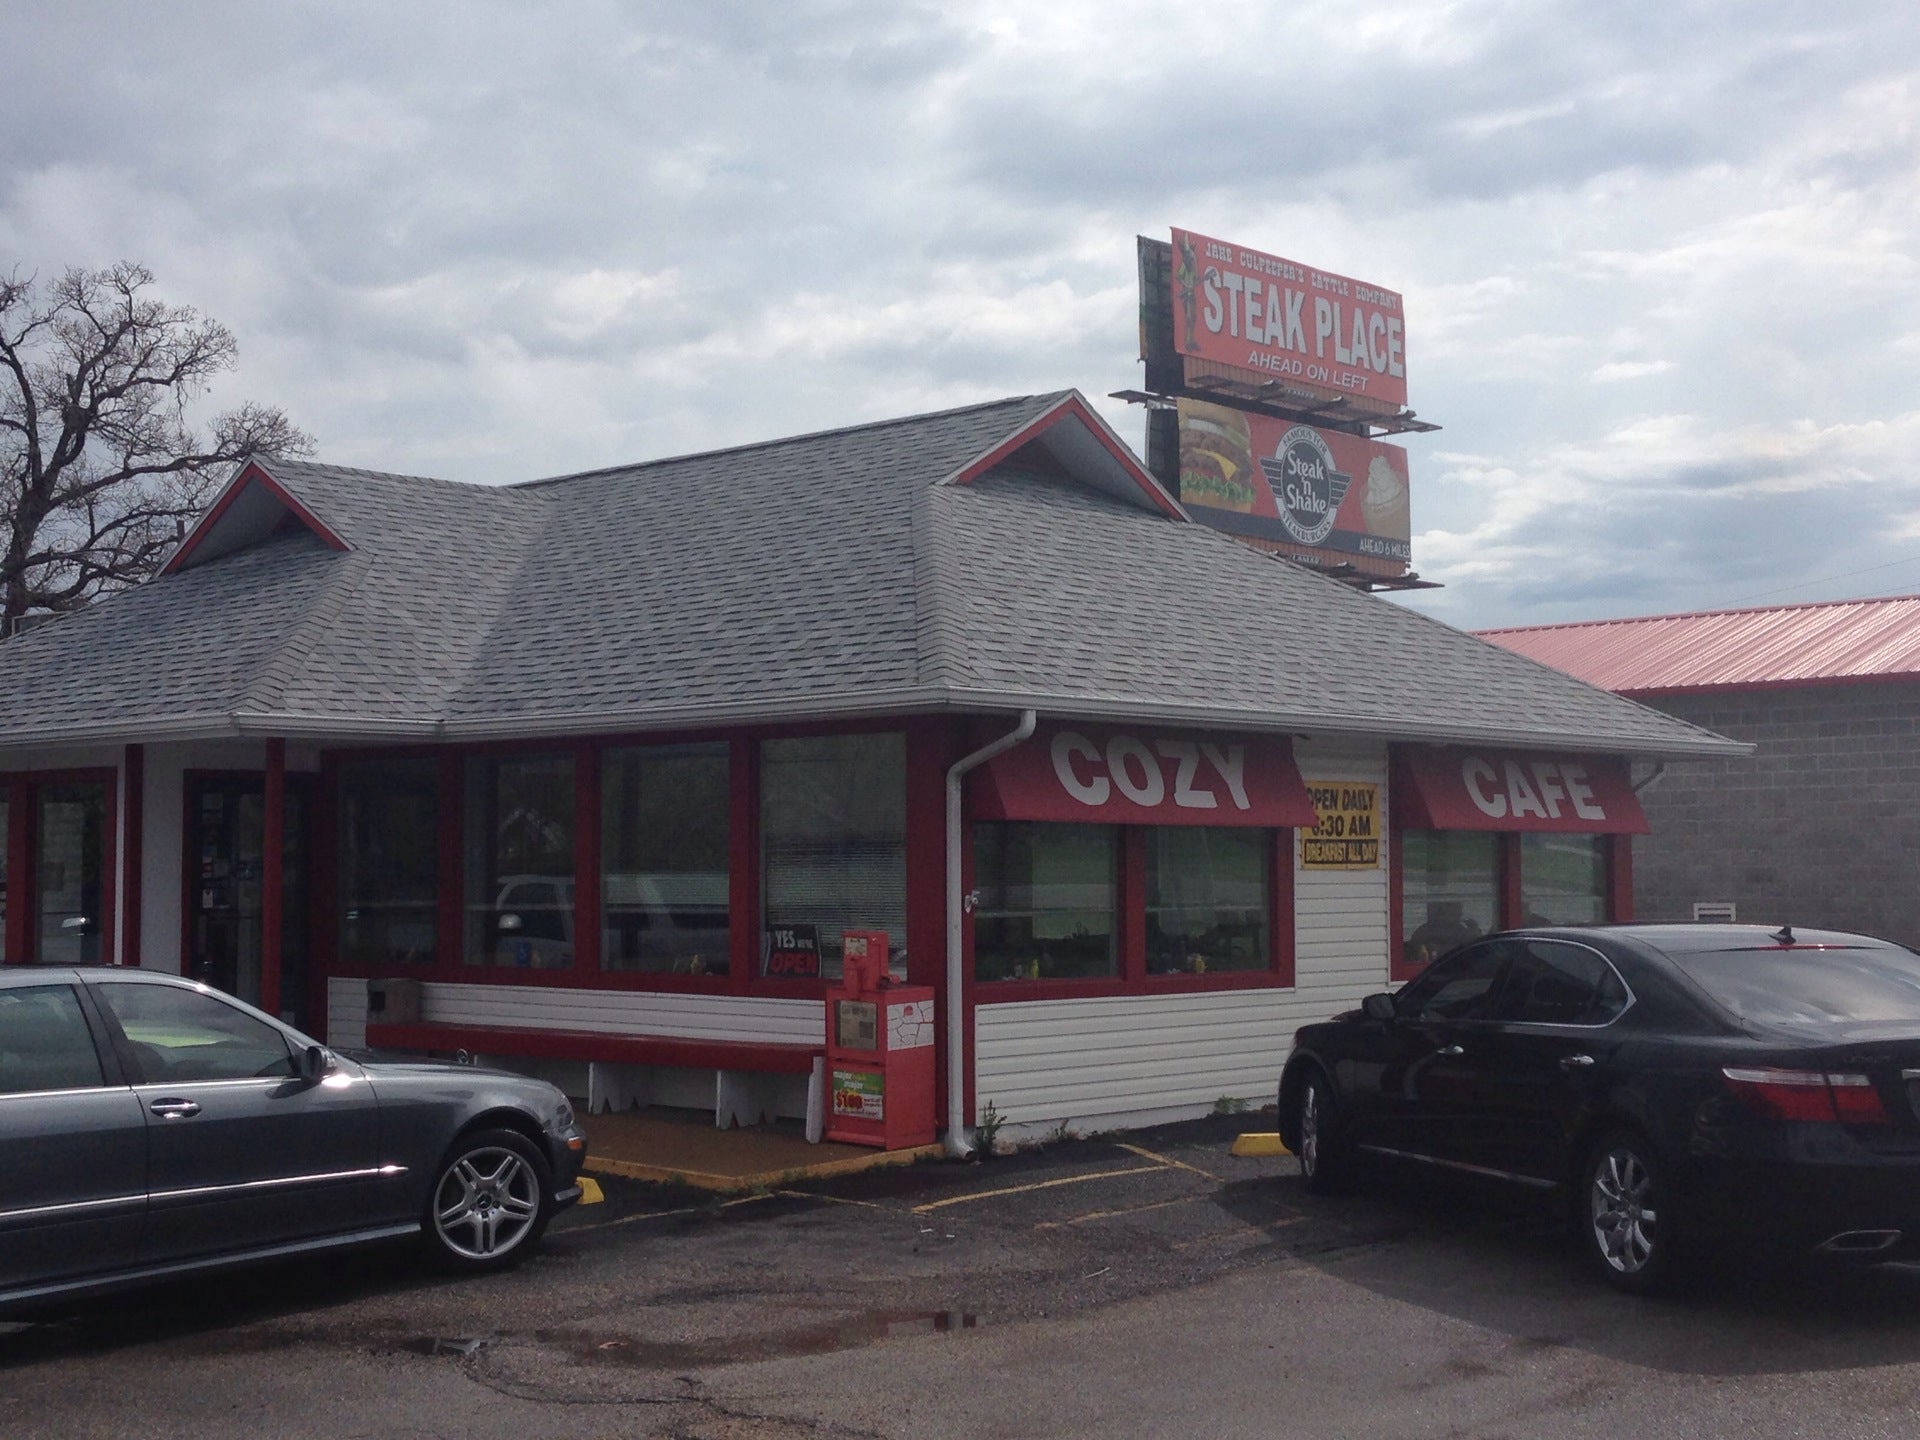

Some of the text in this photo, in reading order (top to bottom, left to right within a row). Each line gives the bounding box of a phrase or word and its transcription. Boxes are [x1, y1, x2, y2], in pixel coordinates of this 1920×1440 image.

[1311, 271, 1348, 297] CATTLE
[1355, 286, 1396, 310] COMPANY
[1203, 266, 1403, 378] STEAK PLACE
[1248, 351, 1368, 391] AHEAD ON LEFT
[1287, 450, 1324, 480] Steak
[1287, 484, 1327, 513] Shake
[1359, 538, 1384, 554] AHEAD
[1391, 543, 1410, 558] MILES
[1051, 731, 1251, 810] COZY
[1342, 788, 1375, 811] DAILY
[1462, 756, 1606, 820] CAFE
[1348, 815, 1371, 836] AM
[775, 930, 796, 949] YES
[770, 953, 818, 974] OPEN
